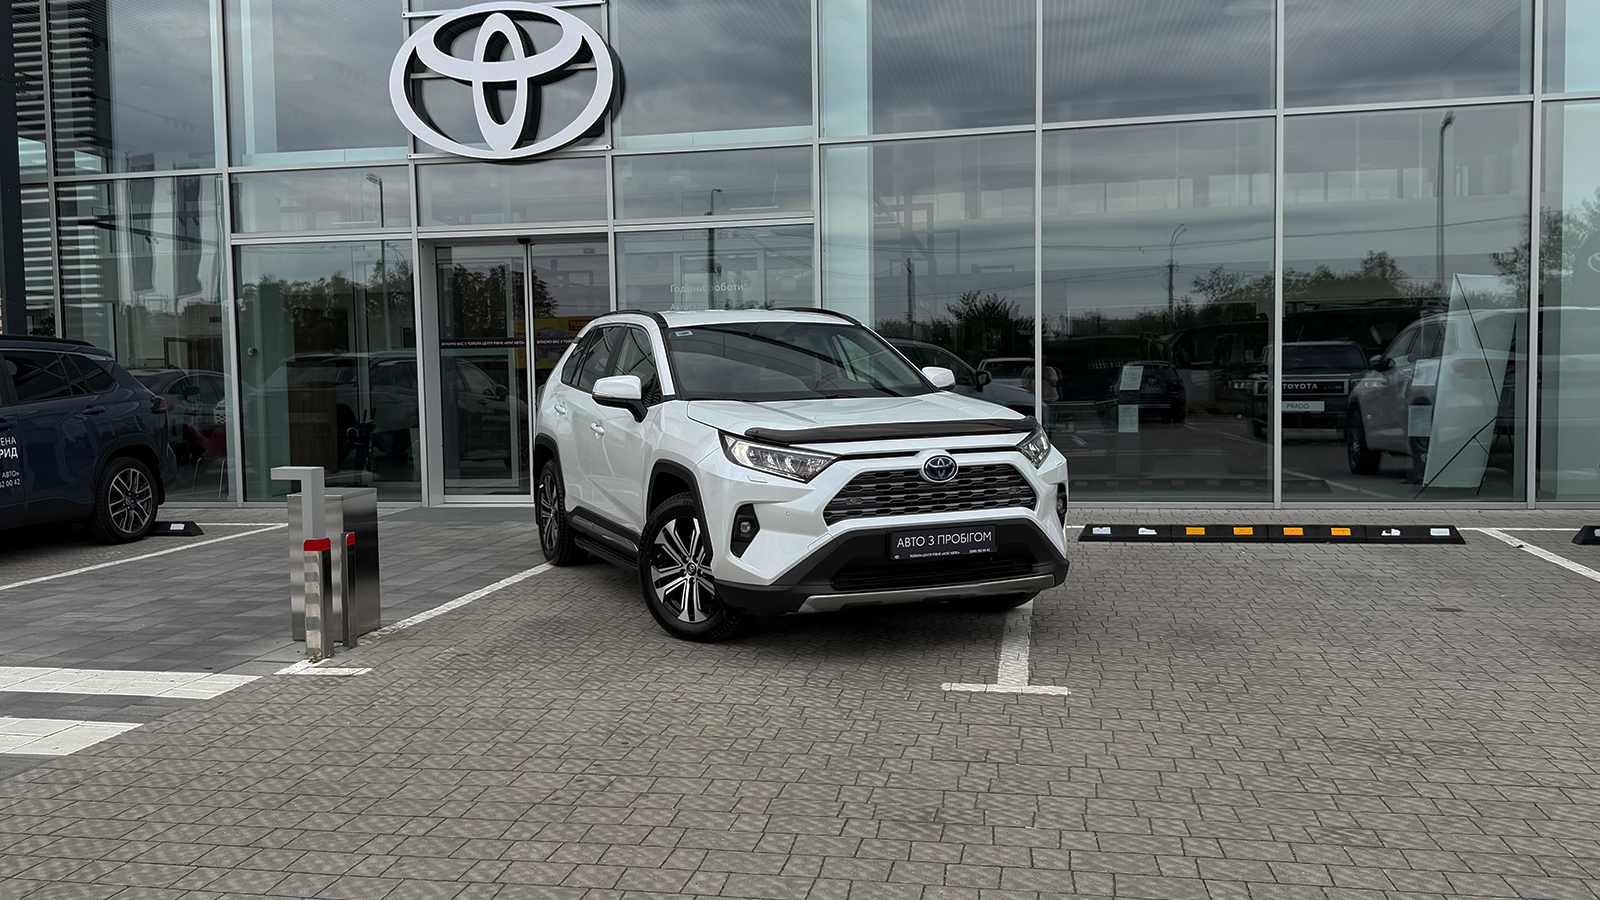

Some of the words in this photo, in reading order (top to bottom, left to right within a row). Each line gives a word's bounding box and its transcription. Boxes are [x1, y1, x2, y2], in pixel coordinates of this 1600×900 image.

[670, 284, 706, 293] Години
[1282, 382, 1318, 390] TOYOTA
[0, 436, 17, 446] ЕНА
[0, 447, 18, 459] РИД
[896, 535, 926, 548] АВТО
[937, 531, 992, 545] ПРОБІГОМ
